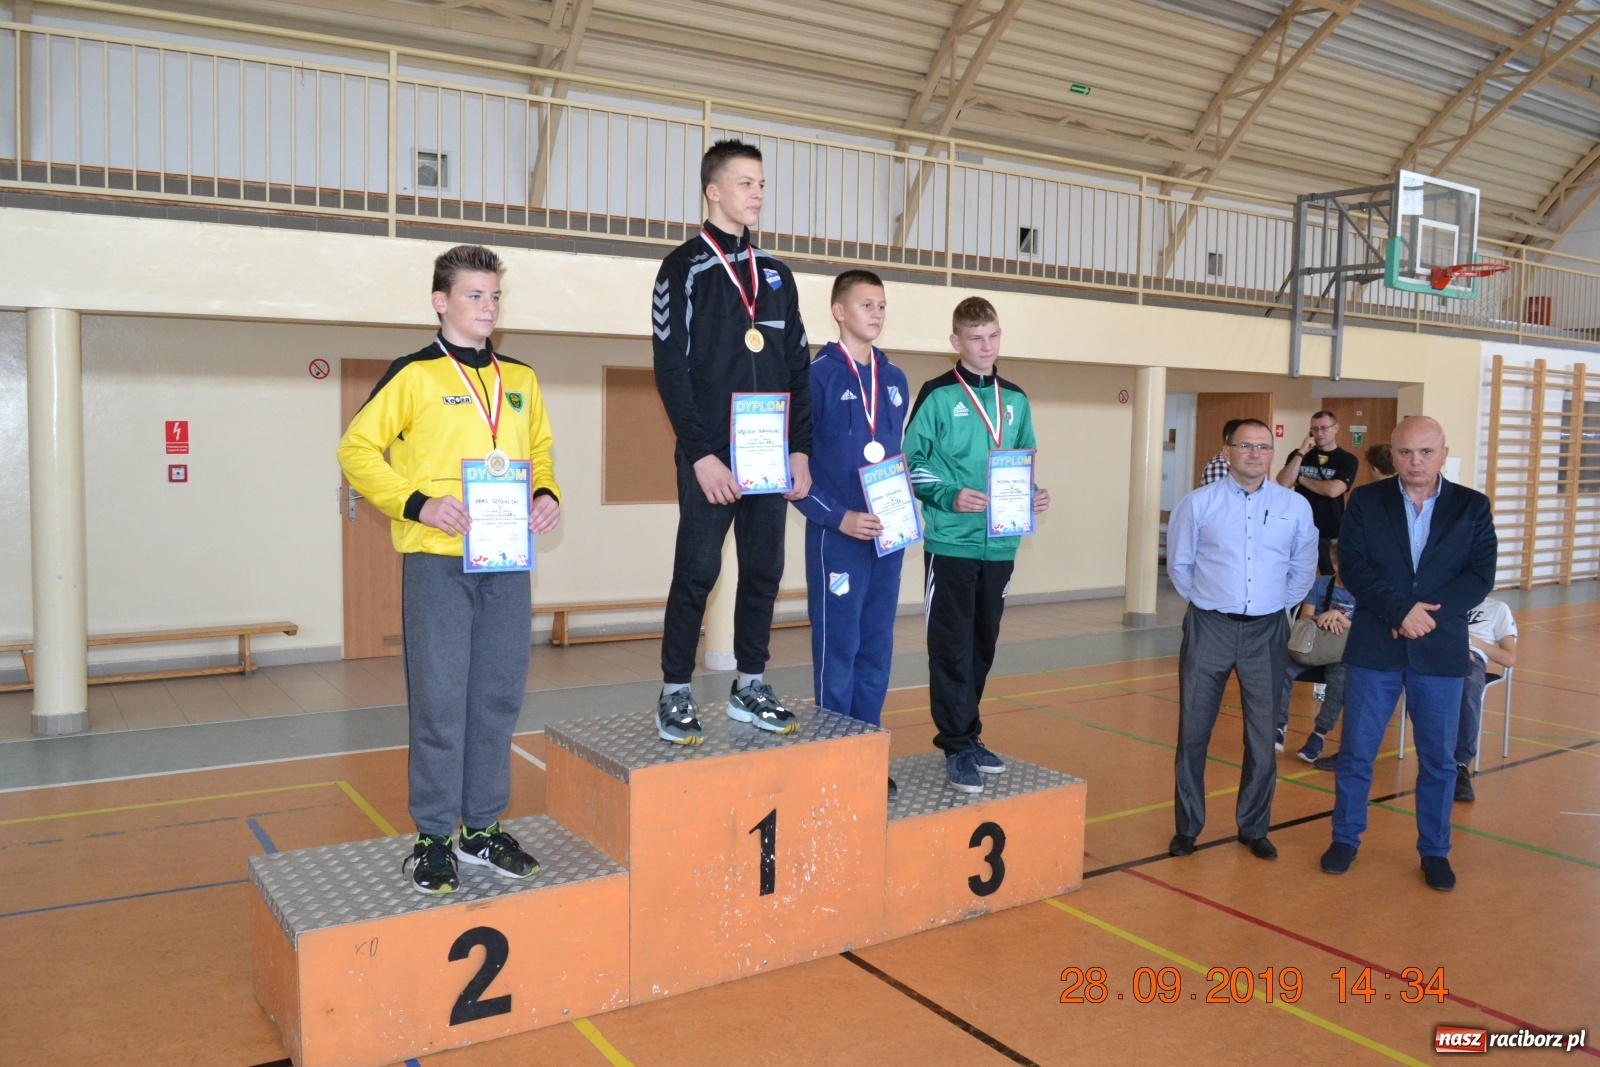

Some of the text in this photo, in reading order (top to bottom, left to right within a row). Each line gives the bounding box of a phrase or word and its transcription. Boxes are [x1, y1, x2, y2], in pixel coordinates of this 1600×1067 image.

[736, 400, 785, 412] DYPLOM
[863, 461, 904, 484] DYPLOM
[992, 455, 1032, 467] DYPLOM
[749, 808, 777, 897] 1
[968, 821, 1007, 897] 3
[448, 926, 512, 1027] 2
